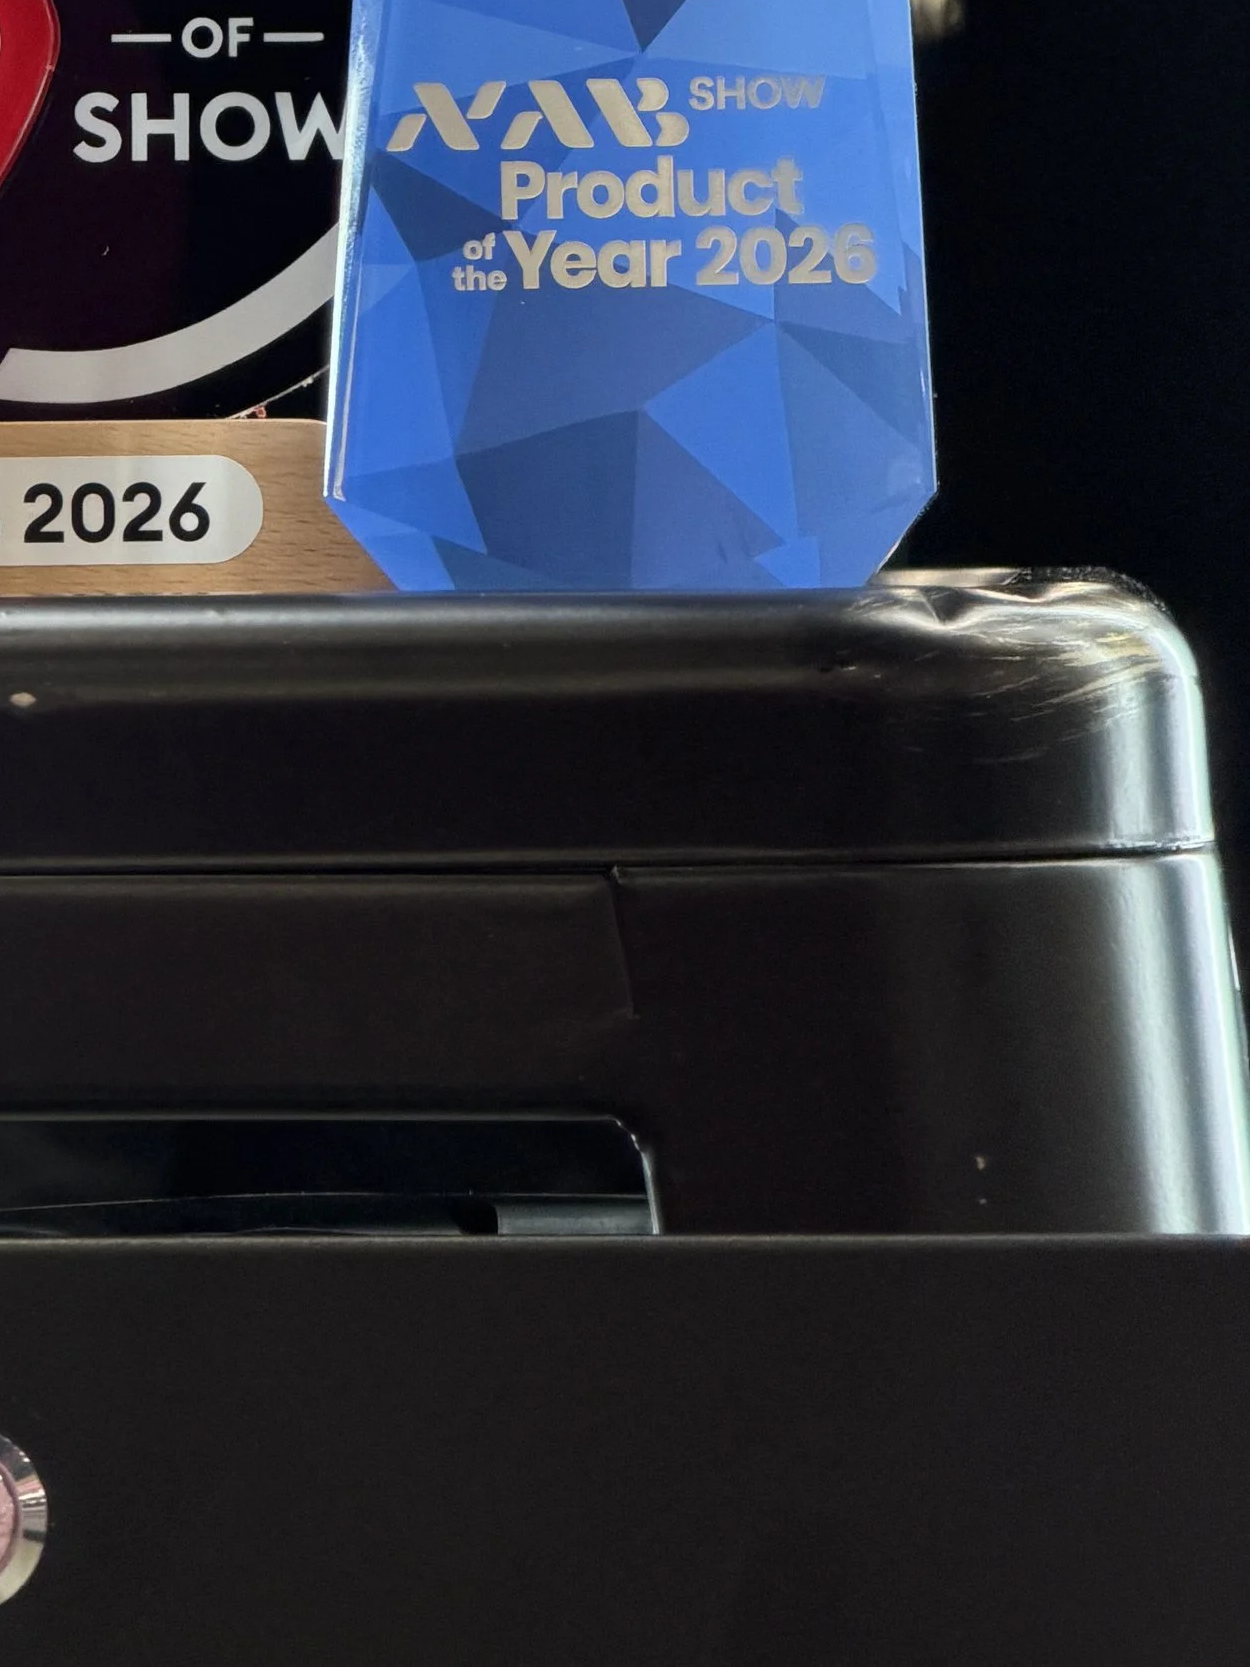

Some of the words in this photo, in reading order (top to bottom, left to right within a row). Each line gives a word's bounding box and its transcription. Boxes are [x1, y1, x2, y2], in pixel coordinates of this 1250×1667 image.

[181, 17, 254, 59] OF
[72, 91, 348, 163] SHOW
[387, 78, 690, 151] NAB
[688, 74, 828, 111] SHOW
[500, 154, 805, 221] Product
[452, 265, 508, 293] the
[462, 232, 497, 262] of
[502, 229, 682, 291] Year
[695, 223, 878, 287] 2026
[23, 481, 211, 544] 2026
